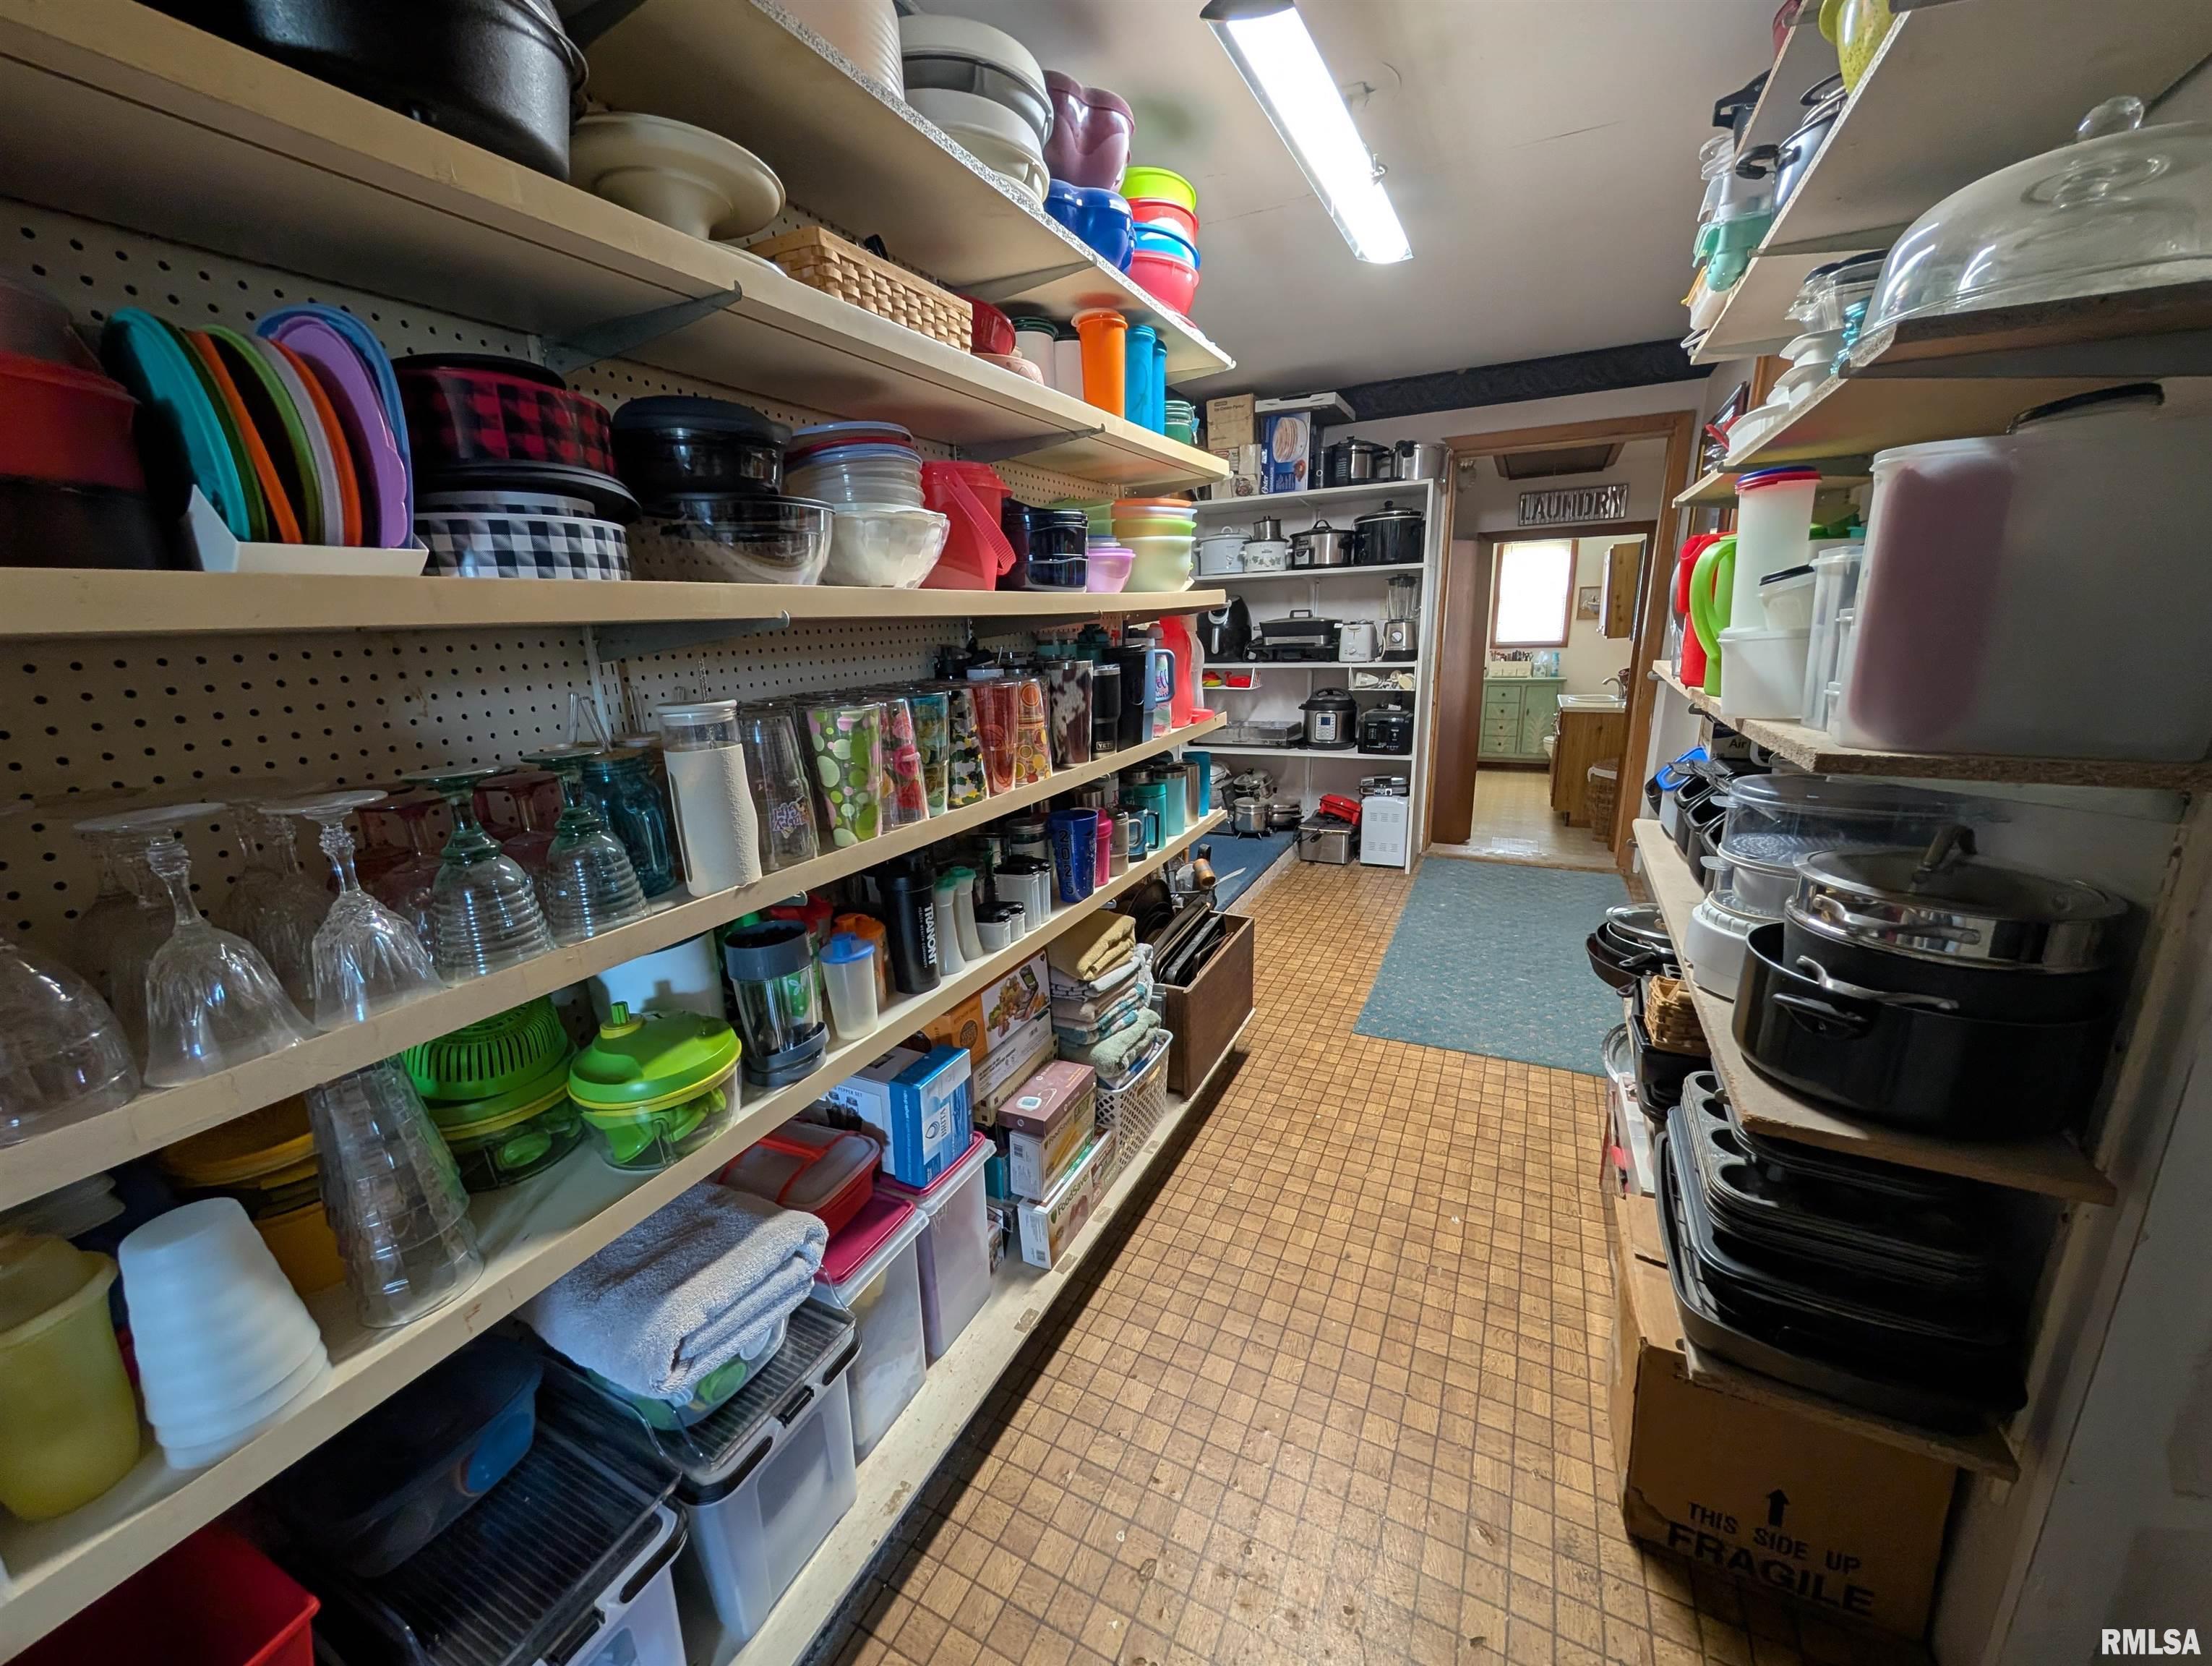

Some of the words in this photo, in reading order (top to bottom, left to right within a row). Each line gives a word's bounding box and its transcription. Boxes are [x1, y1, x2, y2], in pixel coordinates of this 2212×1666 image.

[1521, 488, 1626, 521] LAUNDRY
[1728, 738, 1747, 748] Air
[1059, 830, 1073, 895] 2025
[925, 902, 937, 964] TRANONT
[1057, 1170, 1090, 1216] FoodSaver
[1667, 1520, 1876, 1617] FRAGILE
[1689, 1501, 1739, 1534] THIS
[1753, 1527, 1808, 1560] SIDE
[1825, 1550, 1862, 1574] UP
